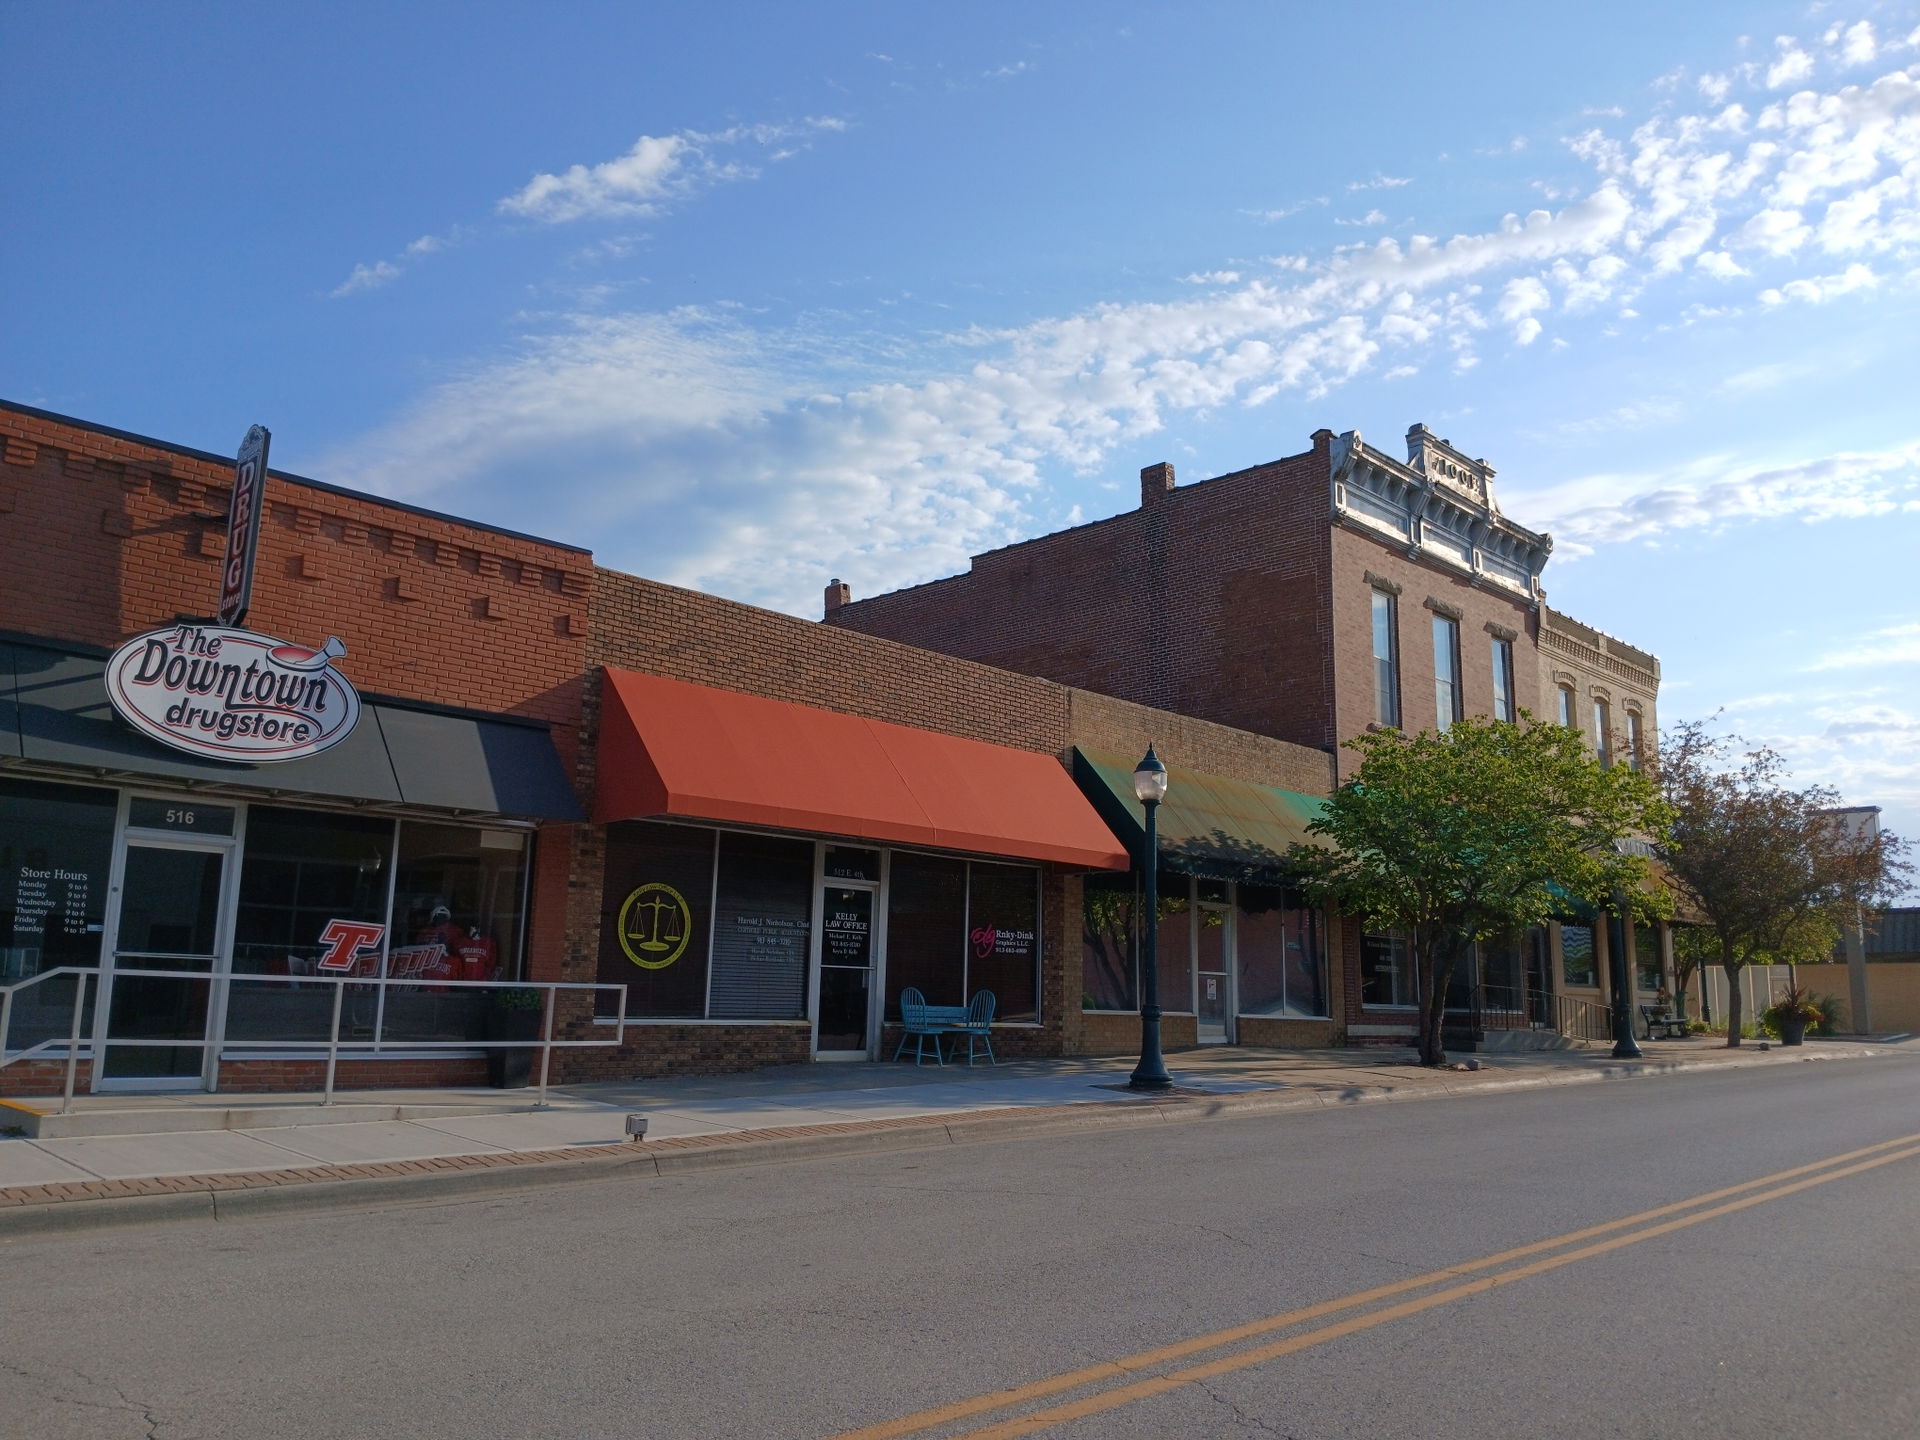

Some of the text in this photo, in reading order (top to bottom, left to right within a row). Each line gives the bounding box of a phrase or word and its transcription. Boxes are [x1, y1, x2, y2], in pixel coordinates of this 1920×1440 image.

[227, 461, 255, 592] DRUG
[220, 592, 241, 611] store
[172, 624, 223, 658] The
[132, 638, 328, 713] Downtown
[164, 697, 311, 743] drugstore
[166, 809, 195, 825] 516
[20, 866, 88, 881] Store Hours
[18, 880, 47, 890] Monday
[83, 883, 88, 891] 6
[17, 889, 47, 899] Tuesday
[67, 891, 73, 899] 9
[16, 898, 57, 908] Wednesday
[15, 906, 48, 916] Thursday
[835, 912, 858, 921] KELLY
[14, 915, 38, 924] Friday
[825, 920, 868, 930] LAW OFFICE
[13, 924, 45, 934] Saturday
[996, 930, 1034, 940] Rnky-Dink
[317, 918, 386, 972] T
